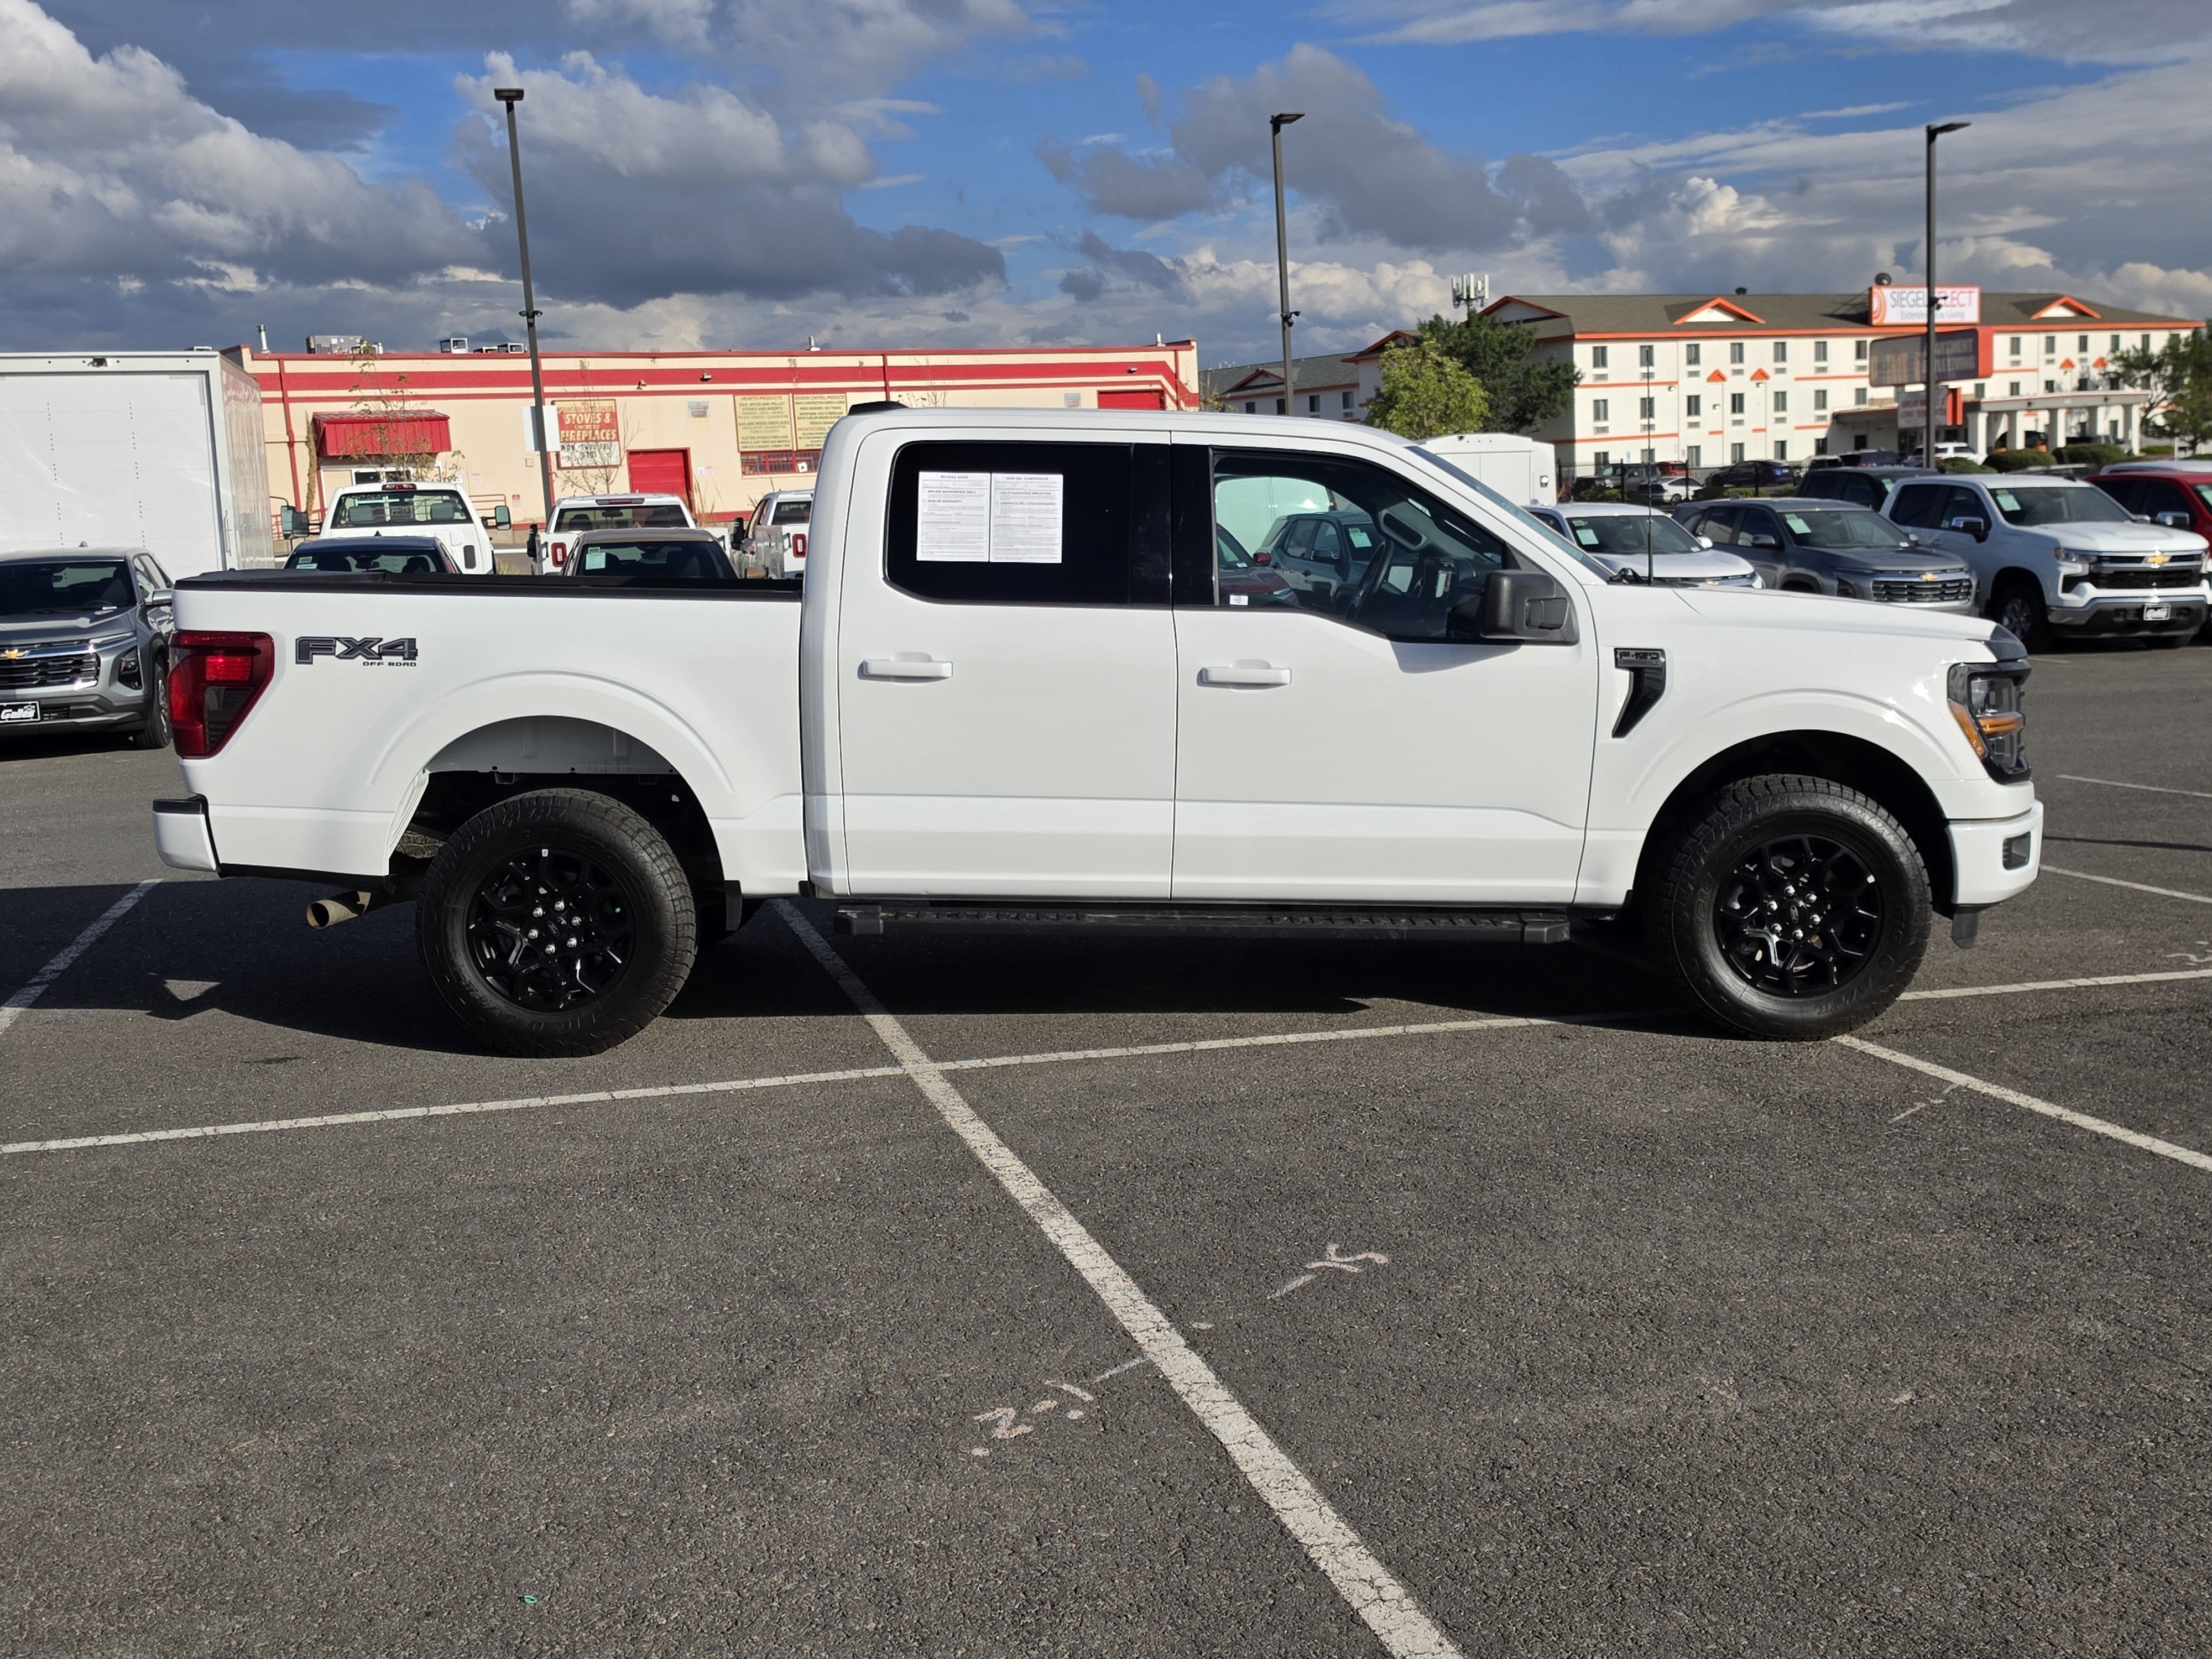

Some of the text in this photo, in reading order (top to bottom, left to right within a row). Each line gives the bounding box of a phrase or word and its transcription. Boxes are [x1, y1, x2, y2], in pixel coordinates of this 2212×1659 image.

[565, 413, 611, 425] STOVES &
[560, 429, 617, 442] FIREPLACES
[295, 637, 418, 665] FX4
